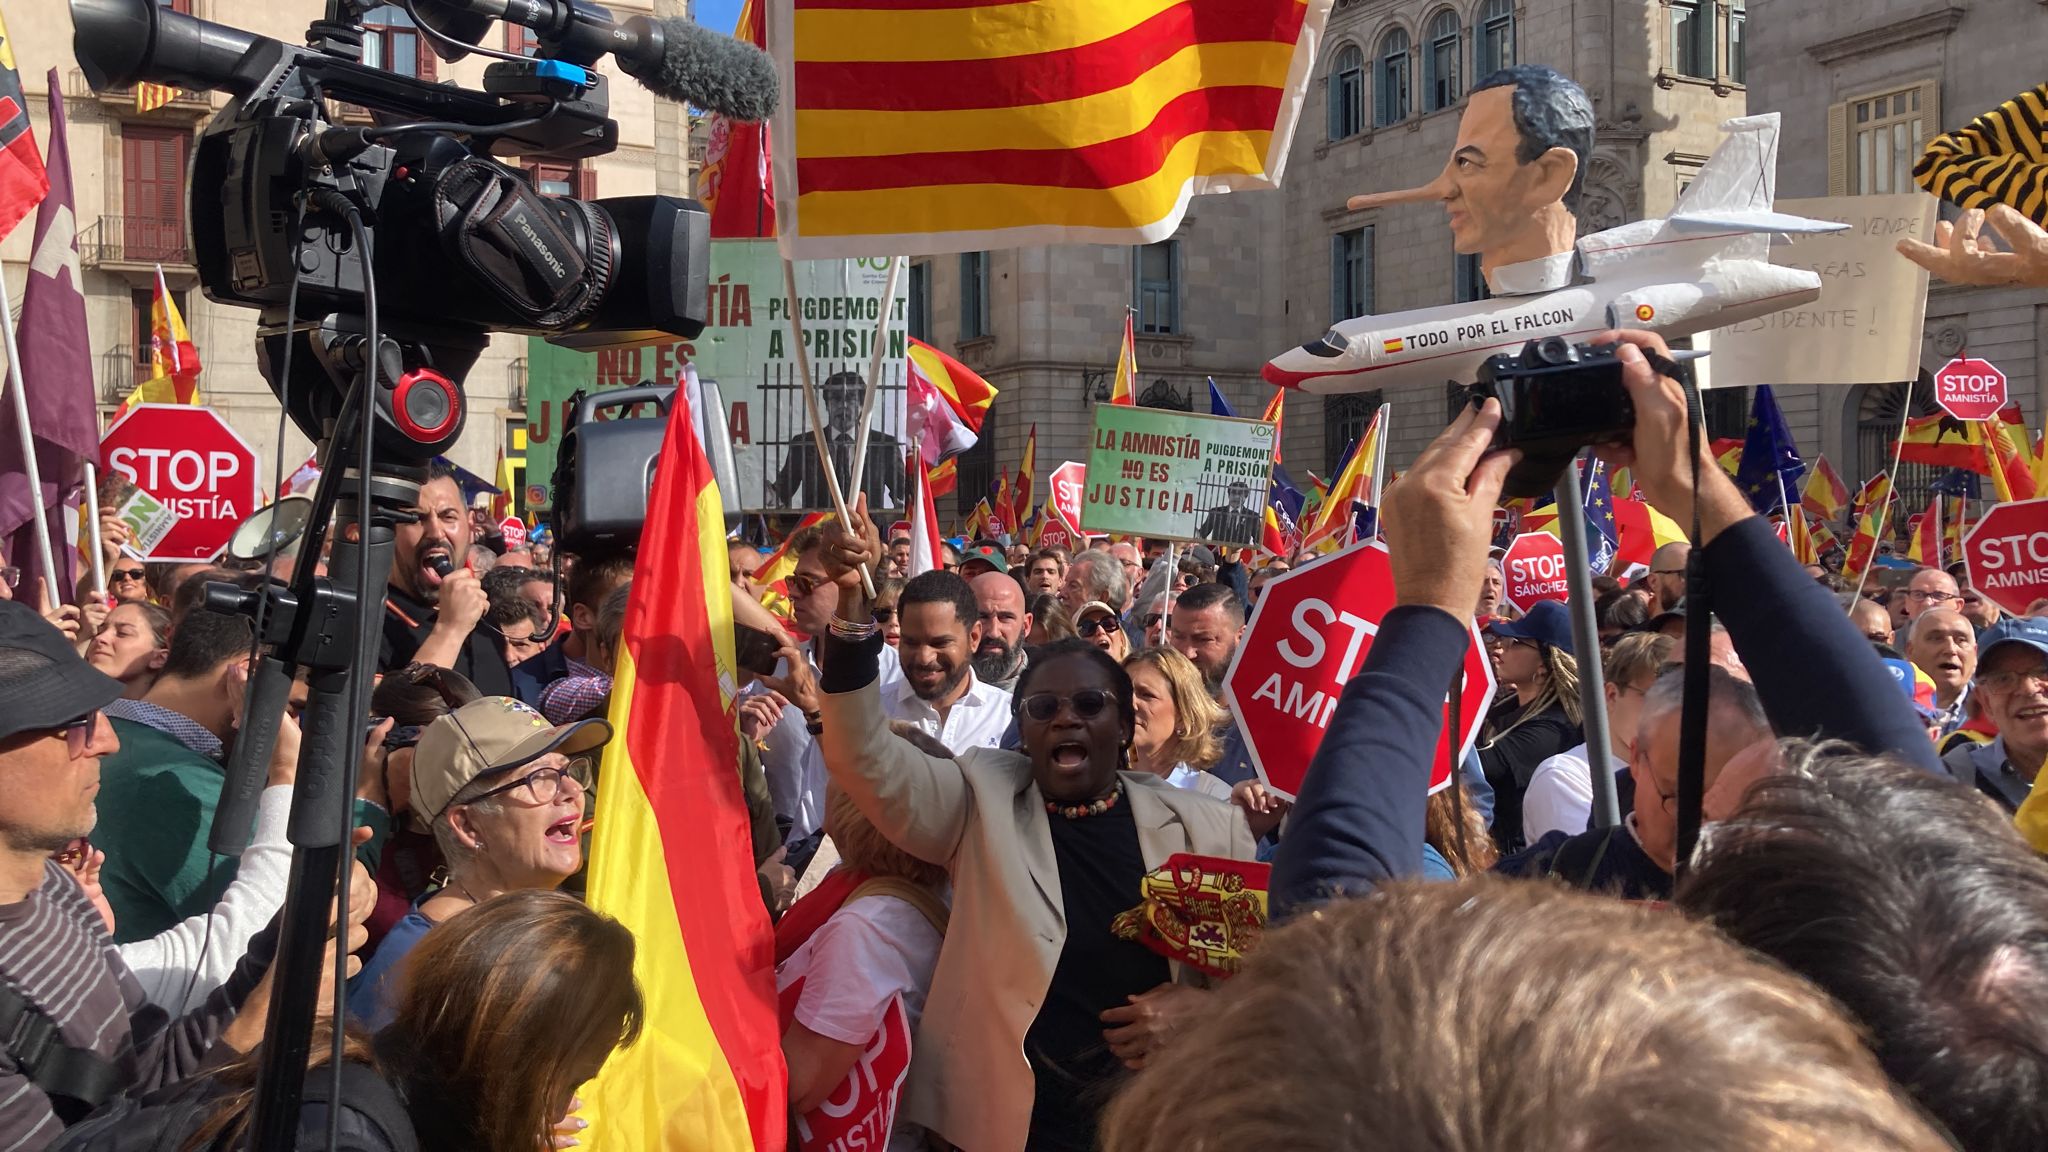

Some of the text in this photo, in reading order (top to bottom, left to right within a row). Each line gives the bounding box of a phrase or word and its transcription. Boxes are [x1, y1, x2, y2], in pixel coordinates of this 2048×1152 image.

[1861, 215, 1921, 236] VENDE
[514, 213, 566, 279] Panasonic
[1406, 308, 1574, 350] TODO POR EL FALCON
[768, 329, 784, 359] A
[596, 343, 697, 385] NO ES
[1943, 374, 1998, 392] STOP
[1944, 392, 1999, 403] AMNISTÍA
[1250, 424, 1274, 437] VOX
[1095, 429, 1201, 460] LA AMNISTÍA
[1206, 442, 1272, 461] PUIGDEMONT
[109, 446, 240, 492] STOP
[1121, 459, 1170, 483] NO ES
[1203, 458, 1269, 479] A PRISIÓN
[1058, 479, 1083, 503] ST
[1089, 483, 1194, 514] JUSTICIA
[504, 525, 525, 539] STOP
[1043, 530, 1067, 546] STOP
[1979, 531, 2048, 570] STO
[1511, 554, 1566, 583] STOP
[1984, 569, 2048, 589] AMNIS
[1514, 579, 1568, 598] SÁNCHEZ
[1276, 598, 1379, 686] ST
